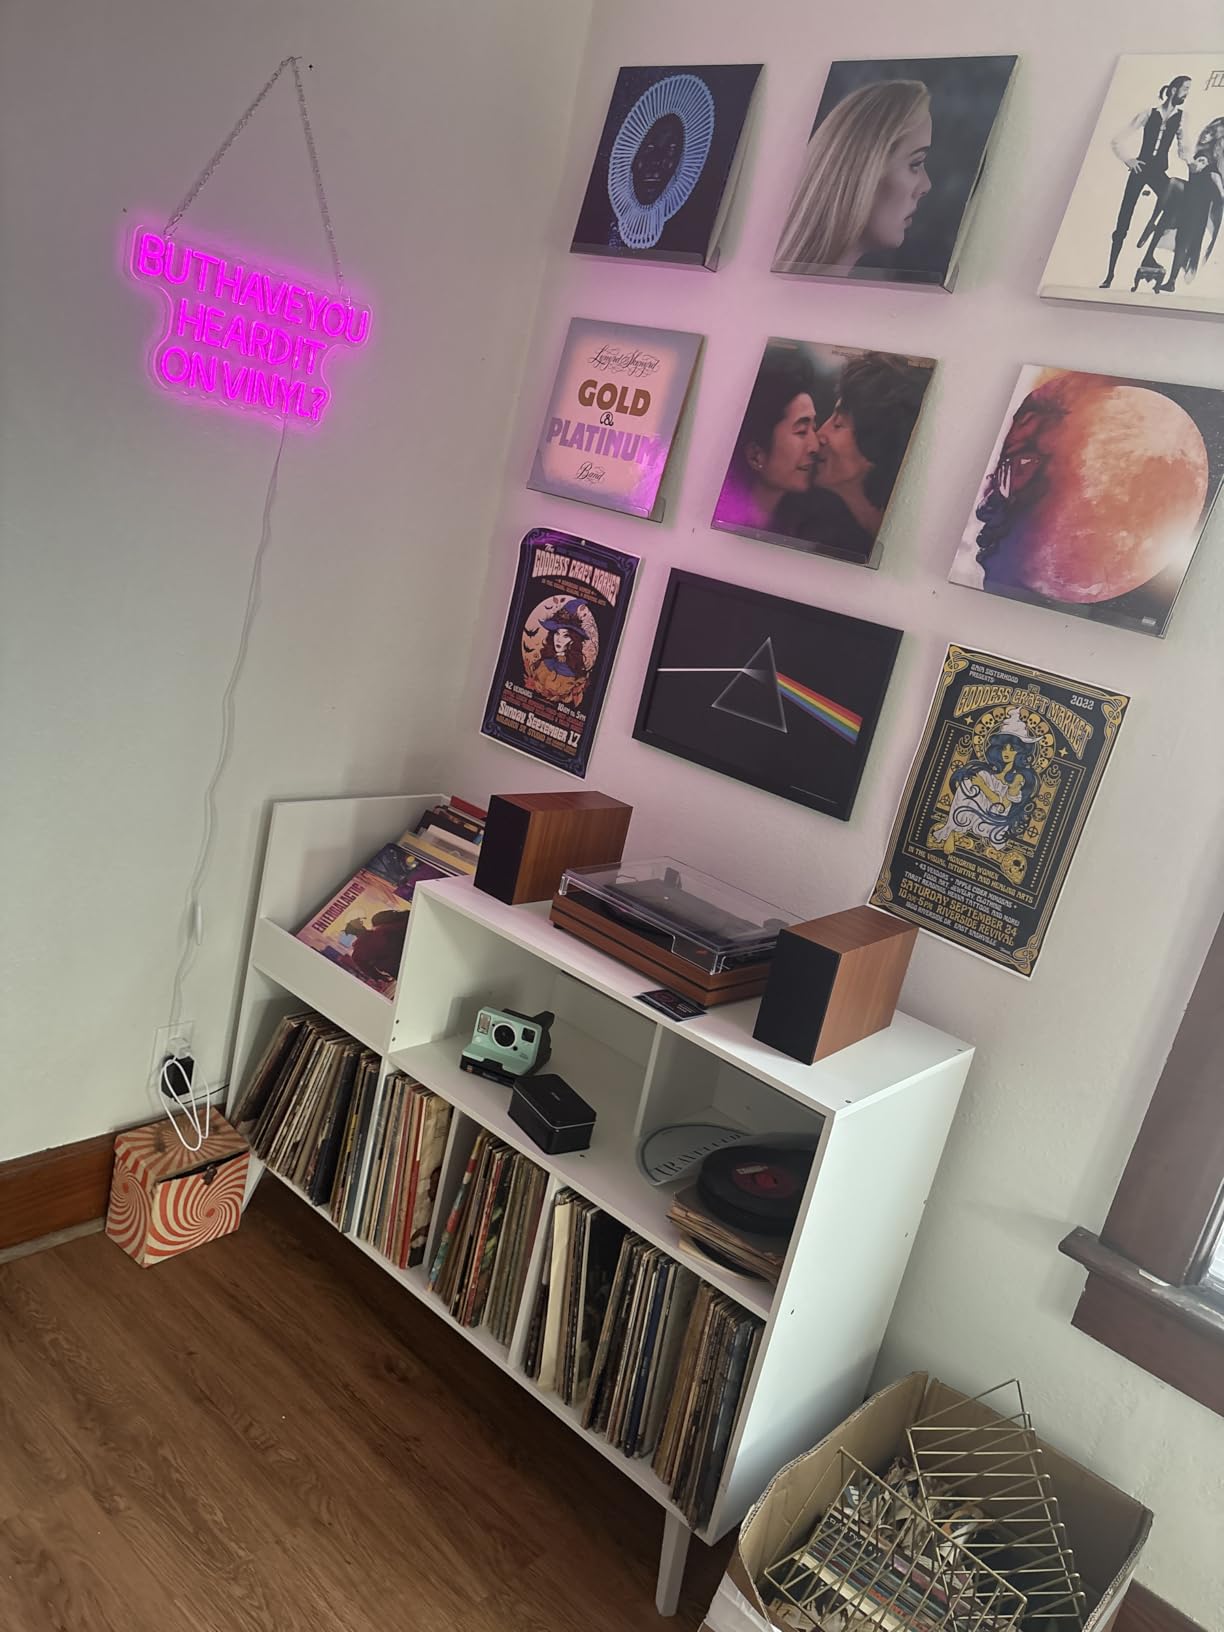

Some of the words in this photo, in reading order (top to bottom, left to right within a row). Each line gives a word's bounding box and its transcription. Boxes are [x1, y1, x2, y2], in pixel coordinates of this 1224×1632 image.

[161, 346, 218, 392] ON
[222, 360, 328, 421] VINYL?
[578, 379, 651, 417] GOLD
[600, 411, 614, 426] &
[547, 418, 659, 467] PLATINUM
[576, 461, 606, 484] Band
[532, 548, 571, 578] GODDESS
[1070, 694, 1095, 710] 2022
[954, 684, 1013, 718] GODDESS
[1012, 688, 1050, 714] CRAFT
[1046, 701, 1093, 759] MARKET
[900, 879, 950, 905] SATURDAY
[949, 900, 1004, 929] SEPTEMBER
[1004, 924, 1018, 936] 24
[1016, 892, 1034, 904] ARTS
[936, 904, 978, 929] RIVERSIDE
[979, 924, 1015, 946] REVIVAL
